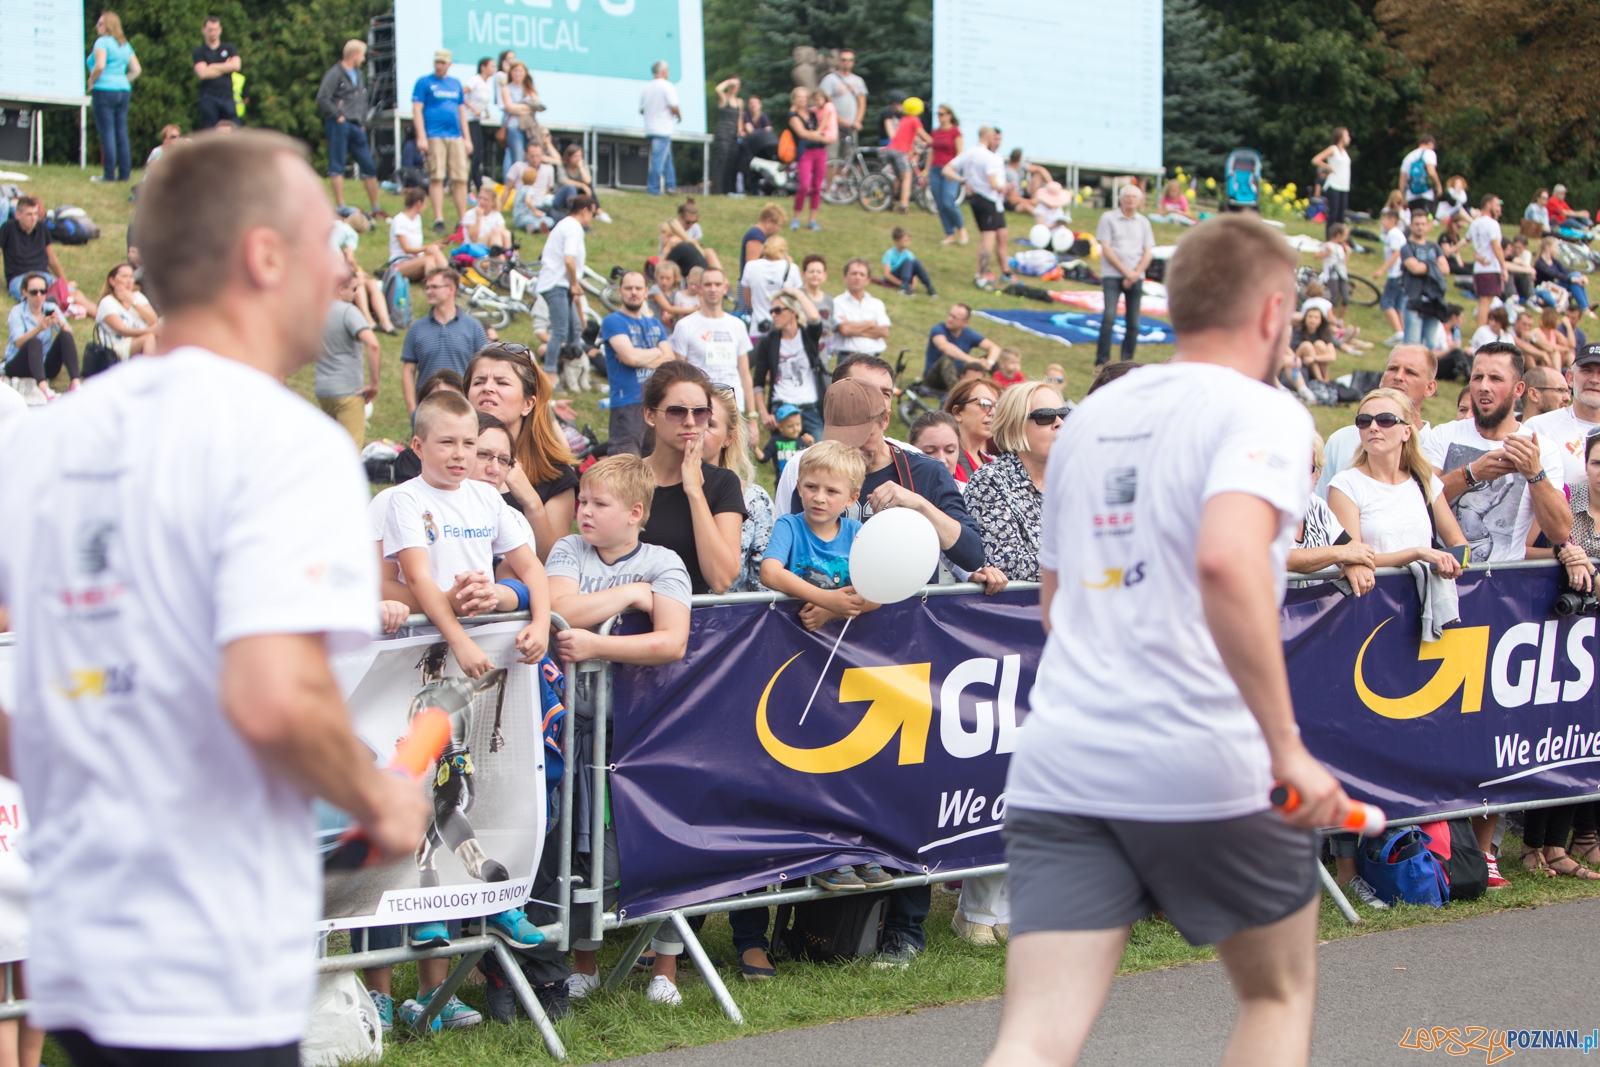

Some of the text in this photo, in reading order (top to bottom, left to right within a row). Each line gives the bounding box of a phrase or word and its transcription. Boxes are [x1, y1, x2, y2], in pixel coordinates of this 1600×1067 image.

[468, 9, 589, 53] MEDICAL
[1491, 617, 1596, 708] GLS
[940, 654, 1024, 759] GL
[1494, 733, 1531, 769] We
[937, 788, 986, 829] We
[388, 884, 529, 912] TECHNOLOGY TO ENJOY
